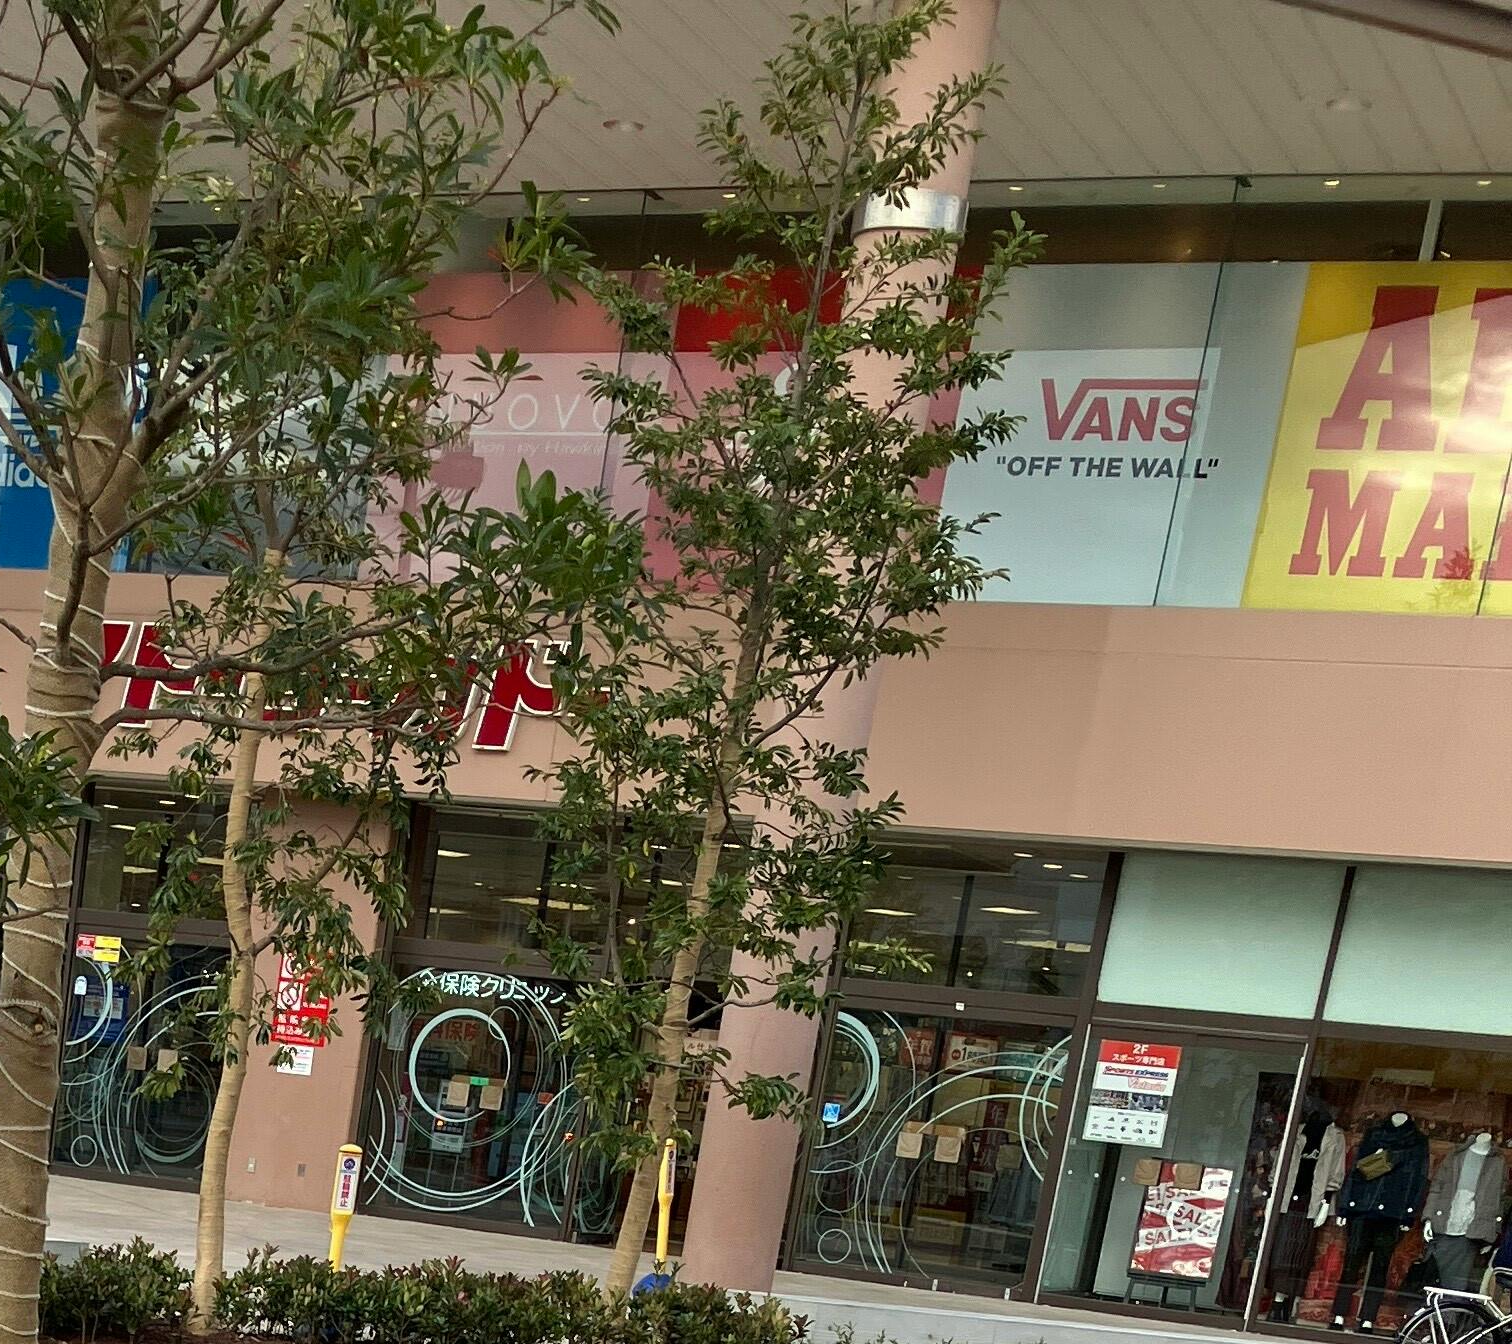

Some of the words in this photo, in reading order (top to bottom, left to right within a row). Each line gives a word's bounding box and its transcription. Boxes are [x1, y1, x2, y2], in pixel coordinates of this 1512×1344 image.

[1041, 377, 1208, 443] VANS
[996, 455, 1061, 478] "OFF
[1069, 456, 1120, 478] THE
[1132, 1043, 1149, 1055] 2F
